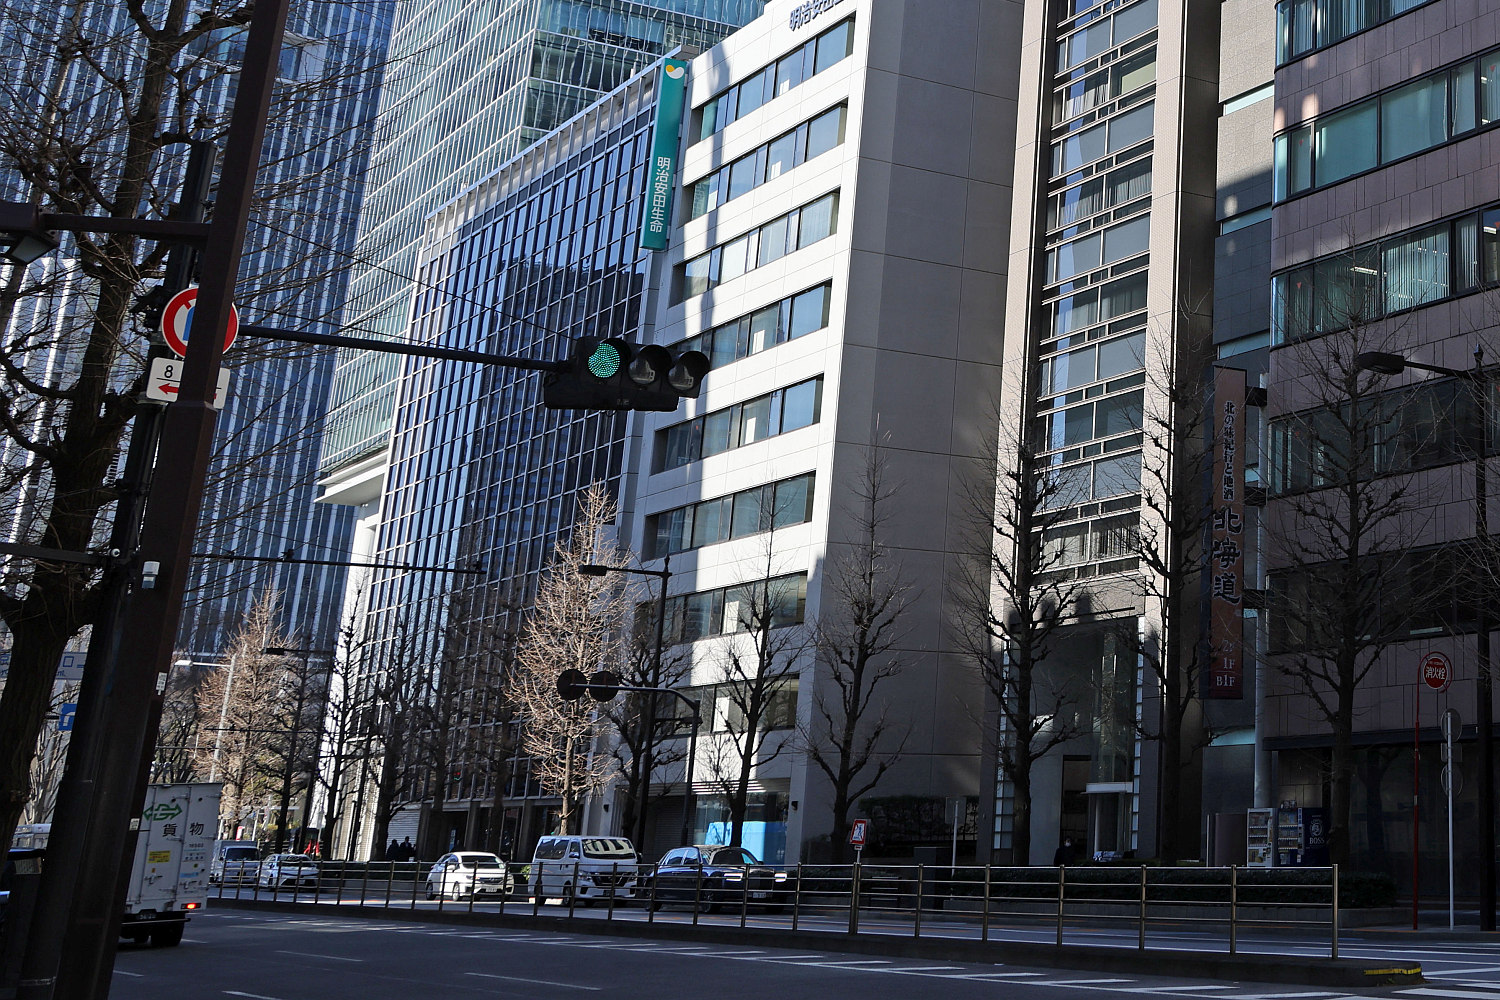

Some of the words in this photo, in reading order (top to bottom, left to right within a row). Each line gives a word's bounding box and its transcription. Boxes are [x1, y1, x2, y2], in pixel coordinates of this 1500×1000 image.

[650, 156, 671, 234] 明治安田生命
[1223, 401, 1236, 500] 北の味紀行と地酒
[1213, 507, 1244, 604] 北海道
[1223, 657, 1236, 670] 1F
[1425, 666, 1446, 680] 消火栓
[1216, 674, 1236, 688] B1F
[162, 823, 204, 837] 貨物
